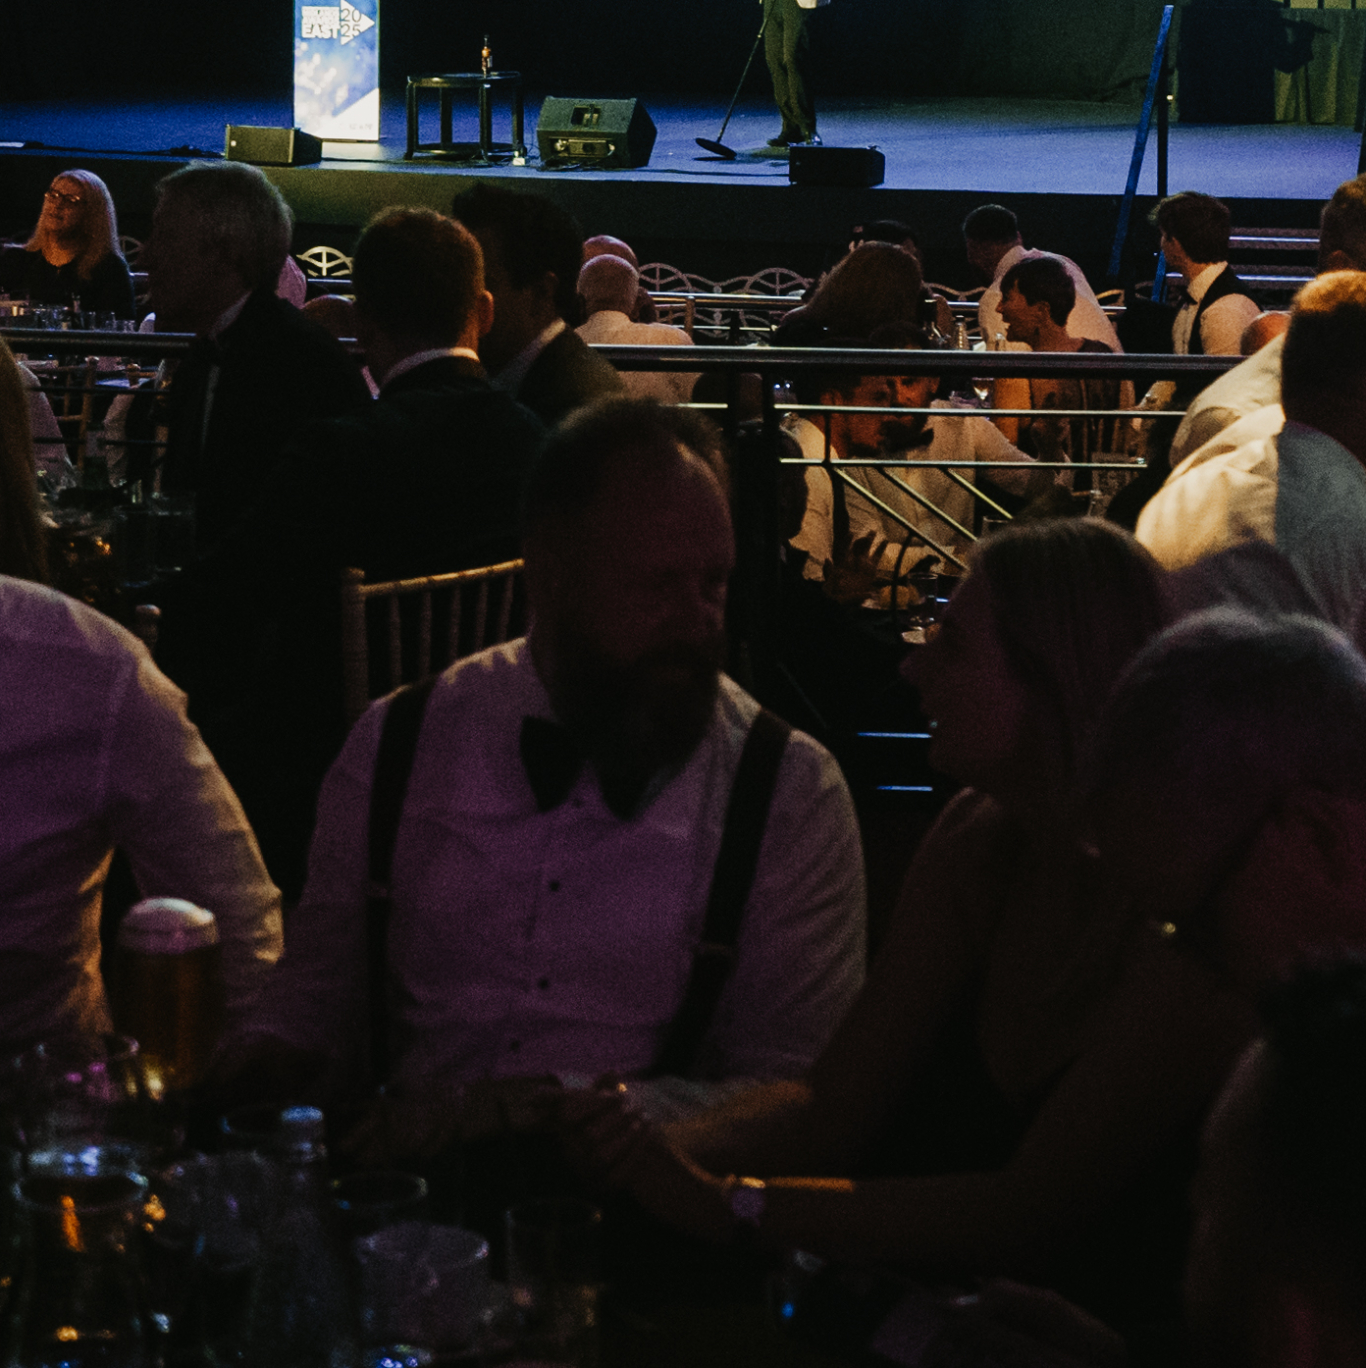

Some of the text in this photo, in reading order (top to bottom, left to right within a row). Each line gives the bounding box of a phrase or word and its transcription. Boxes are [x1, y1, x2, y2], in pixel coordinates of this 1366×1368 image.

[341, 8, 361, 22] 20
[302, 23, 340, 38] EAST
[341, 23, 360, 37] 25
